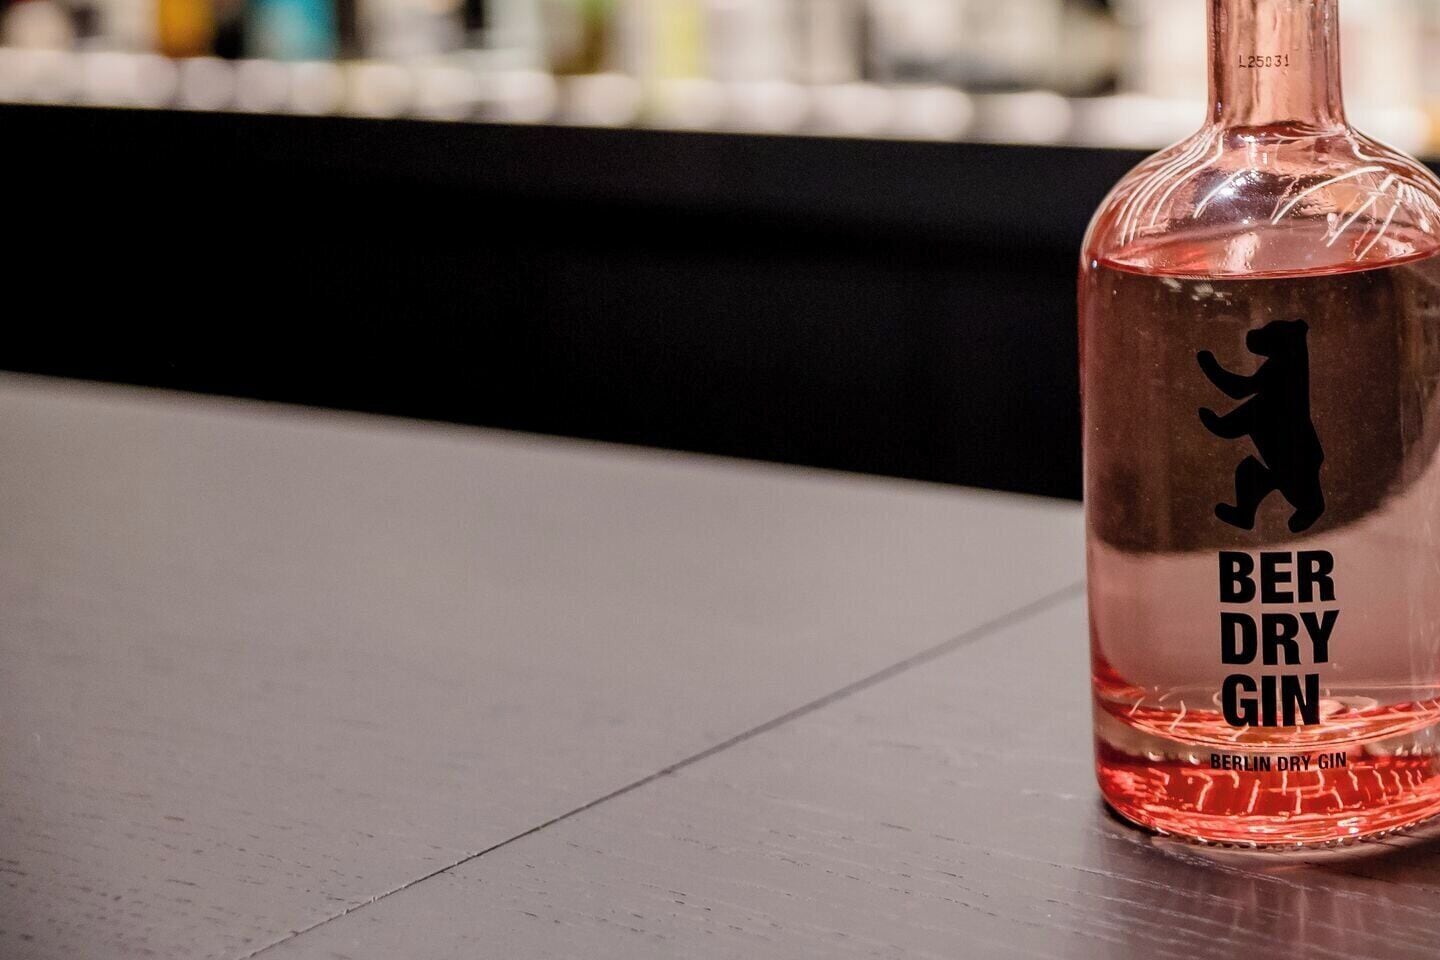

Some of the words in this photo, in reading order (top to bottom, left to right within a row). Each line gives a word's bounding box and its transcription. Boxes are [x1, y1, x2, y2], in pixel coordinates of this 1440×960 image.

[1238, 53, 1290, 68] L25031
[1218, 550, 1336, 605] BER
[1220, 609, 1340, 667] DRY
[1221, 673, 1321, 728] GIN
[1210, 753, 1271, 772] BERLIN
[1277, 754, 1311, 772] DRY
[1318, 751, 1347, 770] GIN
